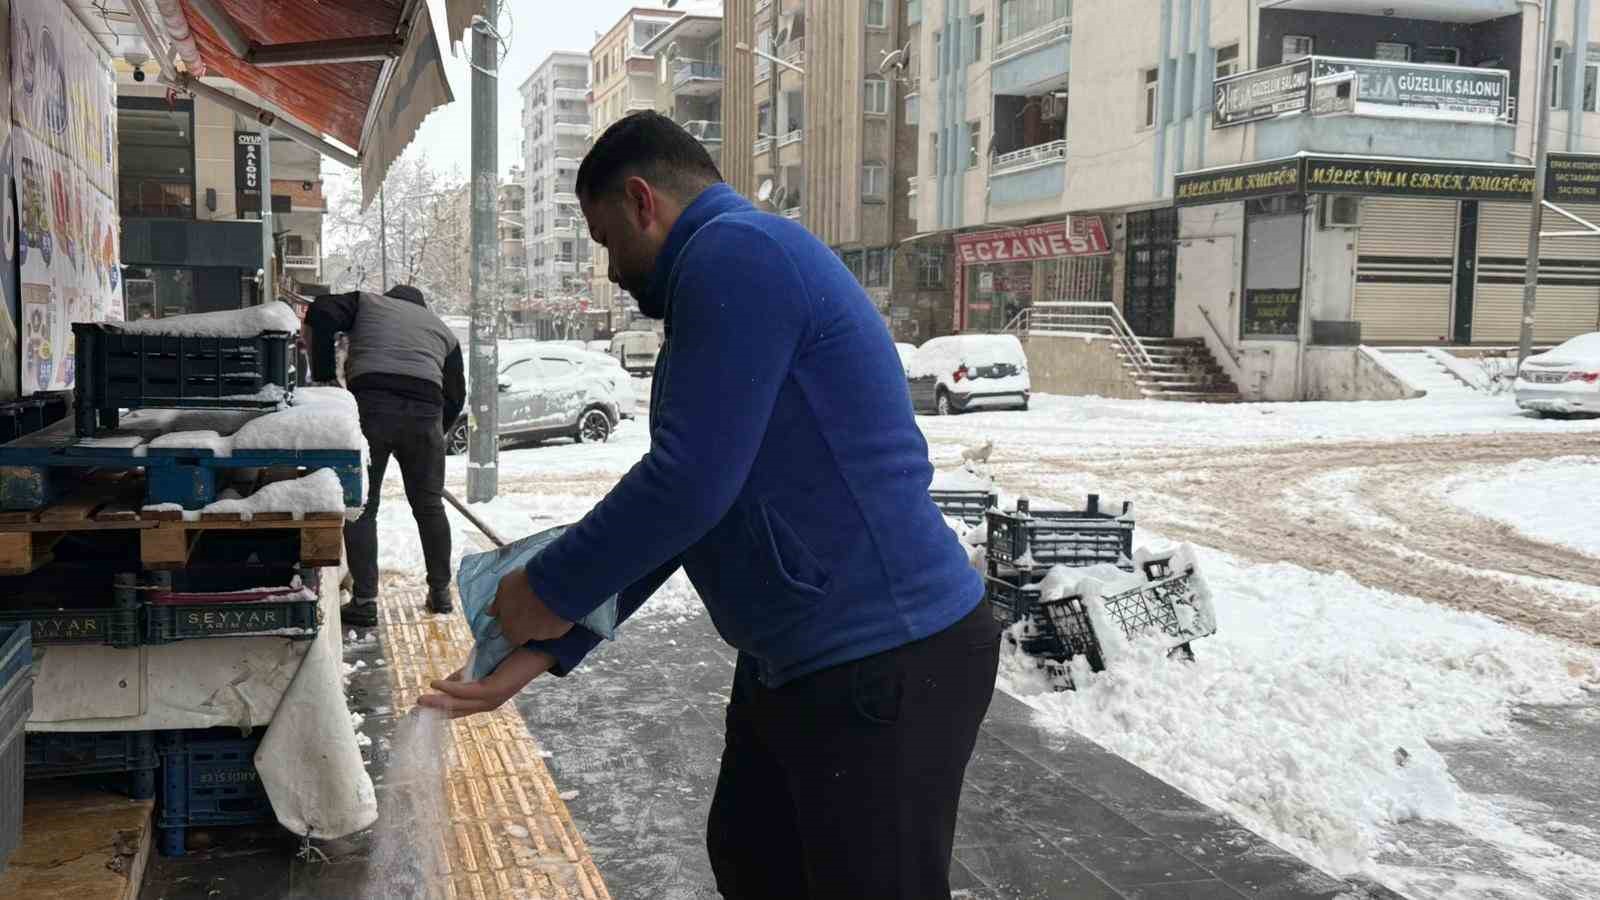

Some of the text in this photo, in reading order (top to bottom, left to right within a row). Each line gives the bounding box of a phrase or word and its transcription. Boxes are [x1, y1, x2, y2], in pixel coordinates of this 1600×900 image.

[1398, 72, 1453, 94] GÜZELLİK
[1455, 79, 1500, 97] SALONU
[246, 145, 257, 187] SALONU
[1410, 172, 1464, 190] ERKEK
[36, 618, 97, 632] YYAR
[188, 610, 277, 624] SEYYAR
